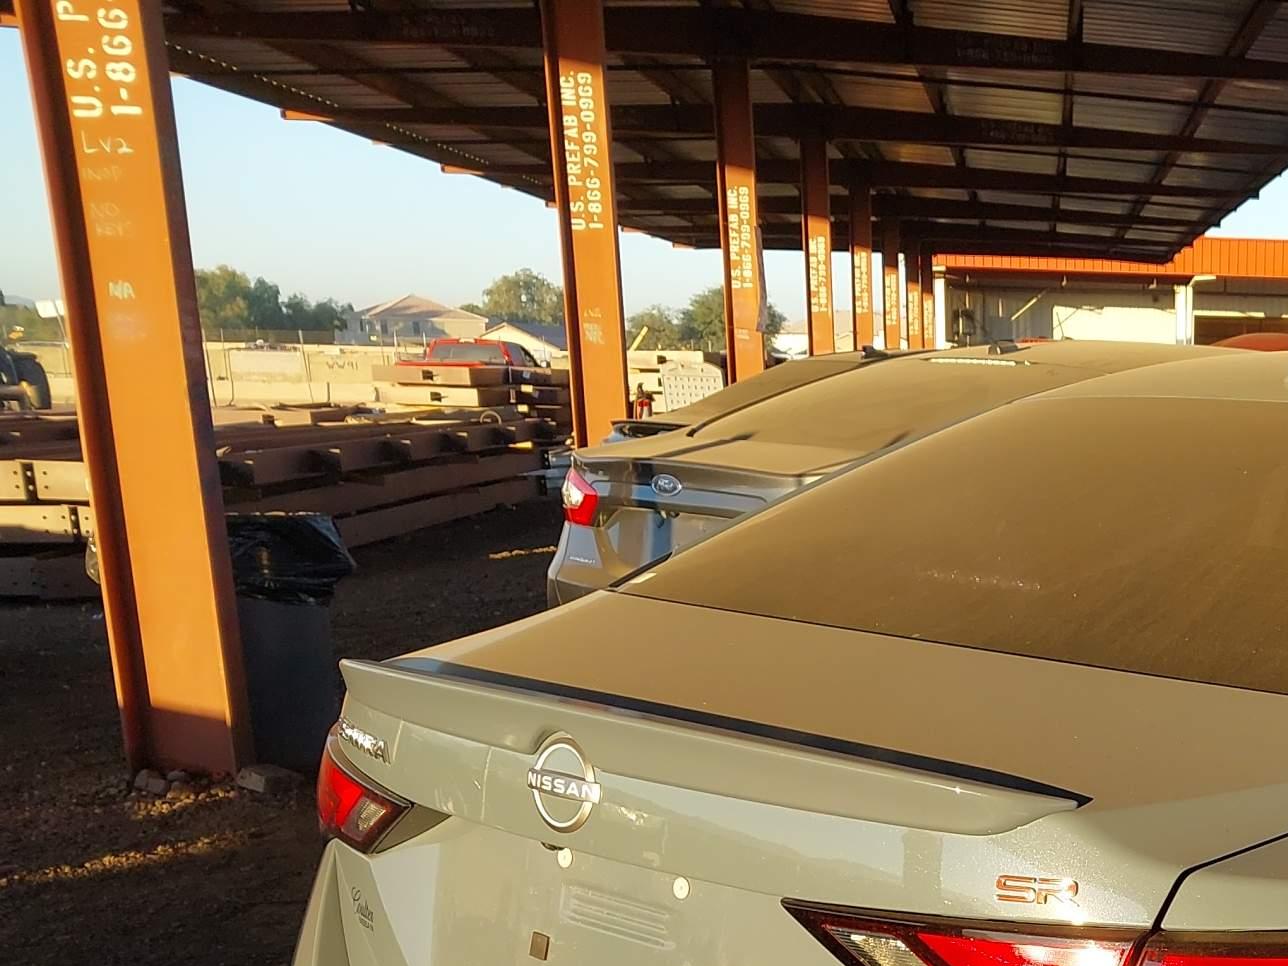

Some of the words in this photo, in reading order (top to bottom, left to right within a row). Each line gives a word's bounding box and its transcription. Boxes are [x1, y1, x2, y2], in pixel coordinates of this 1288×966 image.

[66, 47, 104, 118] U.S.
[97, 0, 143, 116] 1-866
[560, 70, 577, 107] INC.
[563, 114, 583, 187] PREFAB
[577, 72, 604, 229] 1-866-799-0969
[570, 196, 587, 231] U.S.
[528, 771, 600, 804] NISSAN
[995, 875, 1079, 907] SR
